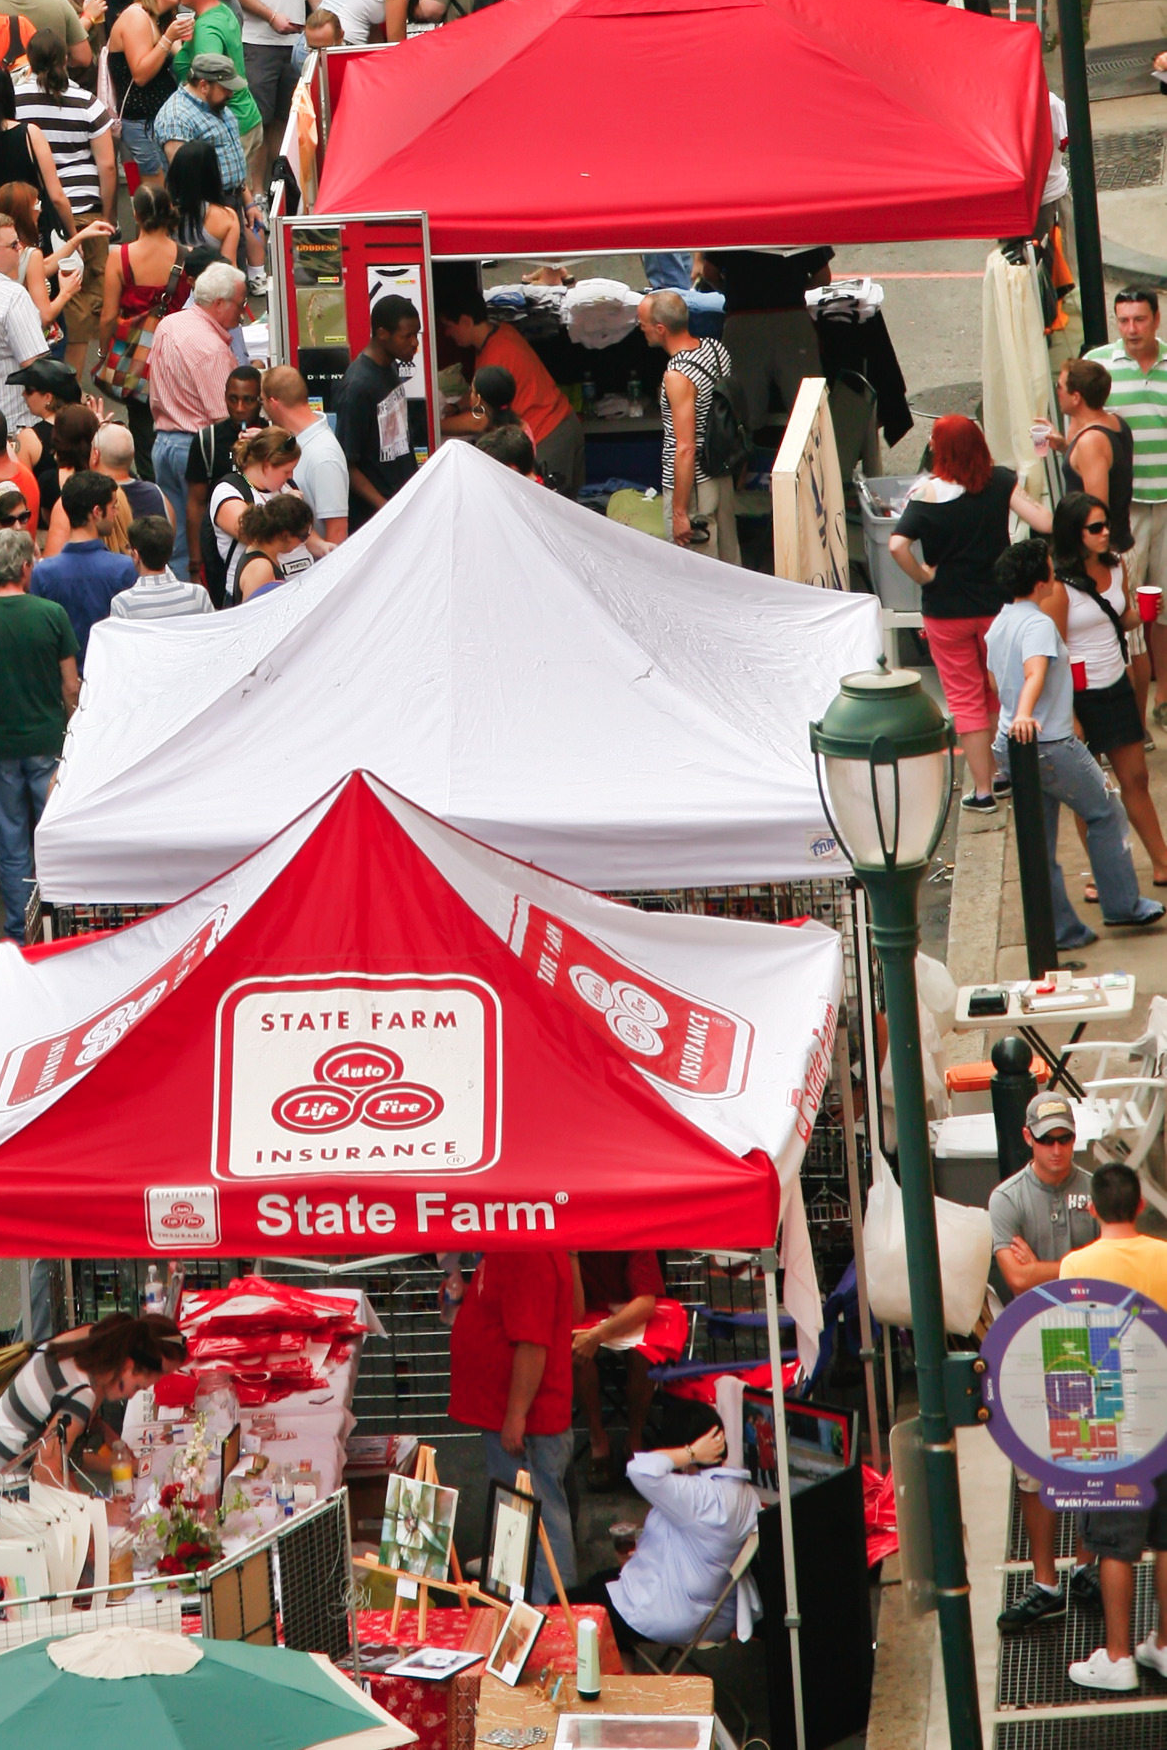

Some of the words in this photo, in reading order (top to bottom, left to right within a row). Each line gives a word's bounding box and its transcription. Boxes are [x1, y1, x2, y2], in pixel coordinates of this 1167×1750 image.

[295, 243, 338, 253] GODDESS
[536, 948, 559, 987] TATE
[260, 1010, 350, 1032] STATE
[370, 1009, 458, 1031] FARM
[678, 1010, 710, 1085] INSURANCE
[332, 1062, 386, 1079] Auto
[295, 1101, 339, 1121] Life
[375, 1099, 421, 1115] Fire
[255, 1140, 458, 1165] INSURANCE
[255, 1192, 397, 1237] State
